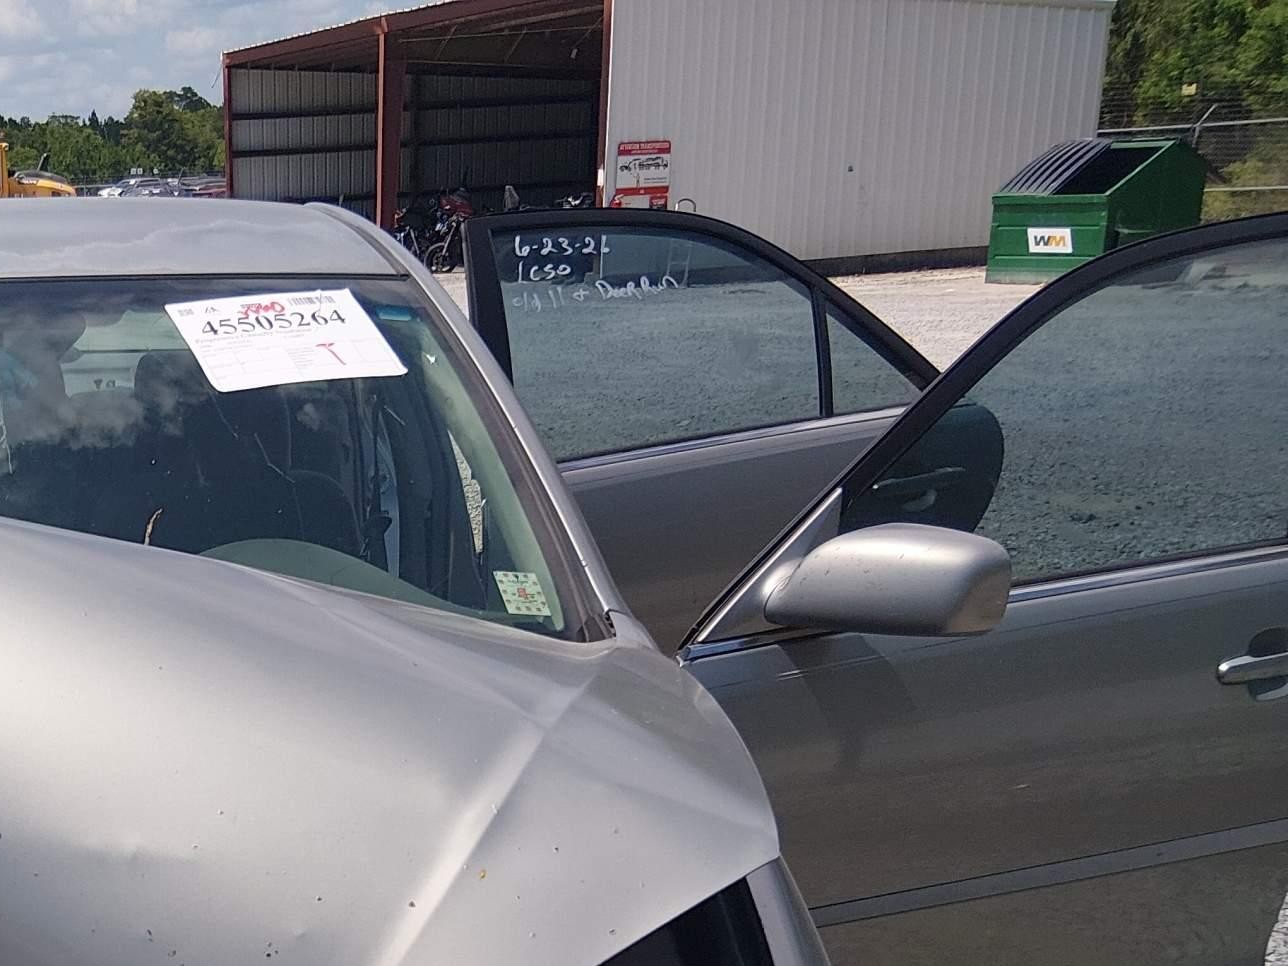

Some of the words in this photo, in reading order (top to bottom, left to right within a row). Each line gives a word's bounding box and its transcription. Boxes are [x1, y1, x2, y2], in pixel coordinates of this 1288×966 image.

[514, 234, 610, 257] 6-23-26
[1034, 235, 1066, 247] WM
[202, 309, 346, 335] 45505264
